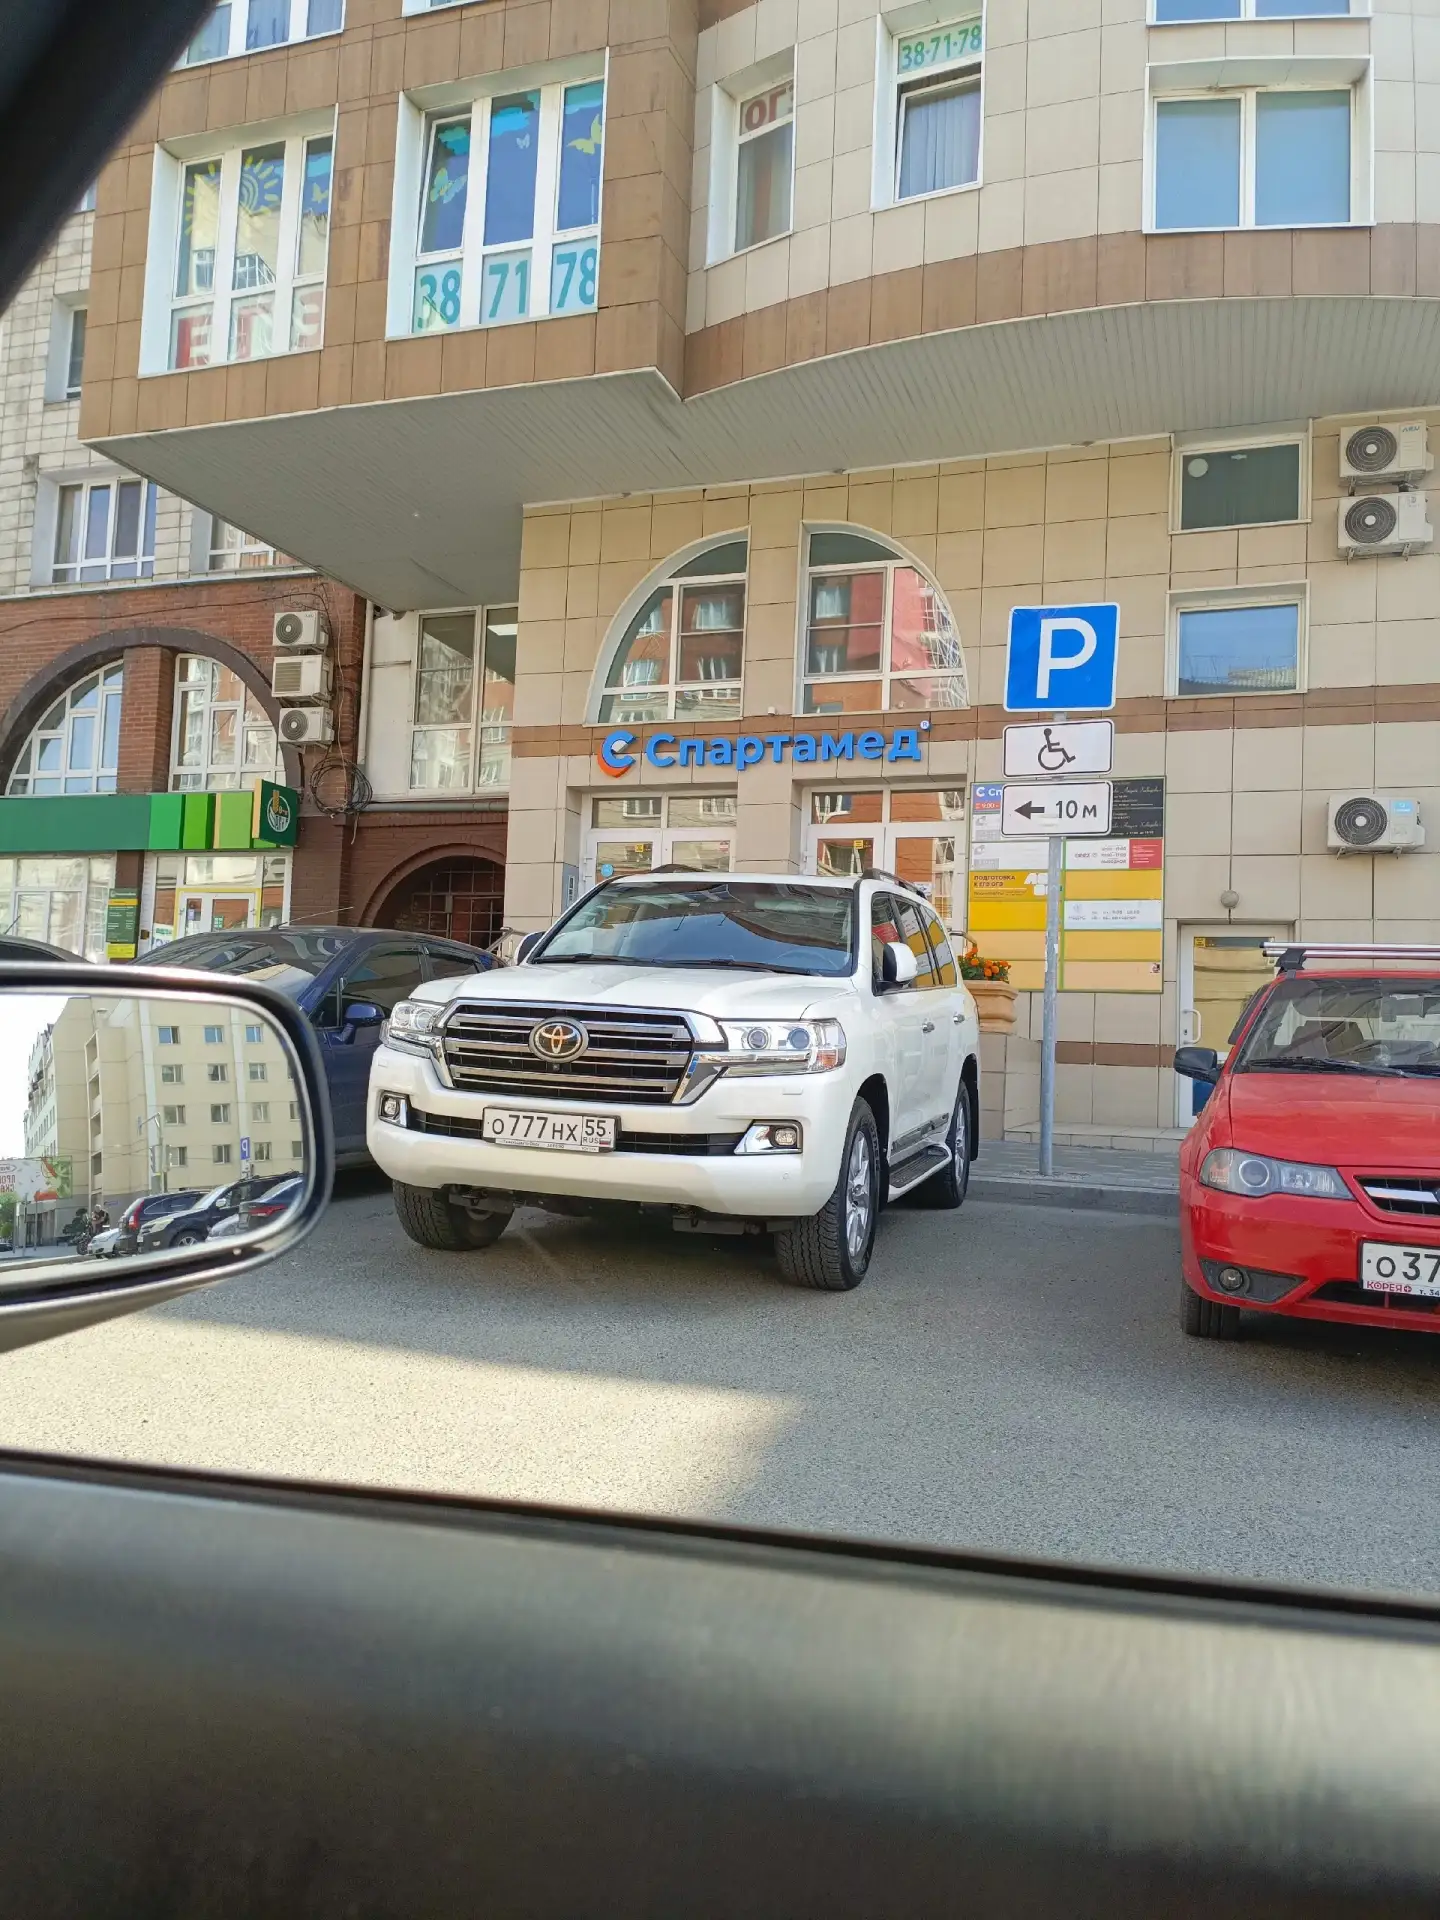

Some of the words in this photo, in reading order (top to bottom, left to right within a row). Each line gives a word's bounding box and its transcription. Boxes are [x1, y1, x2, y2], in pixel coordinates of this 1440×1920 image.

[488, 259, 528, 318] 71
[556, 248, 597, 309] 78
[1036, 617, 1097, 698] P
[646, 729, 922, 771] Спартамед
[1055, 800, 1078, 819] 10
[585, 1119, 606, 1137] 55
[582, 1136, 599, 1144] RUS
[1367, 1281, 1403, 1292] КОРЕЯ
